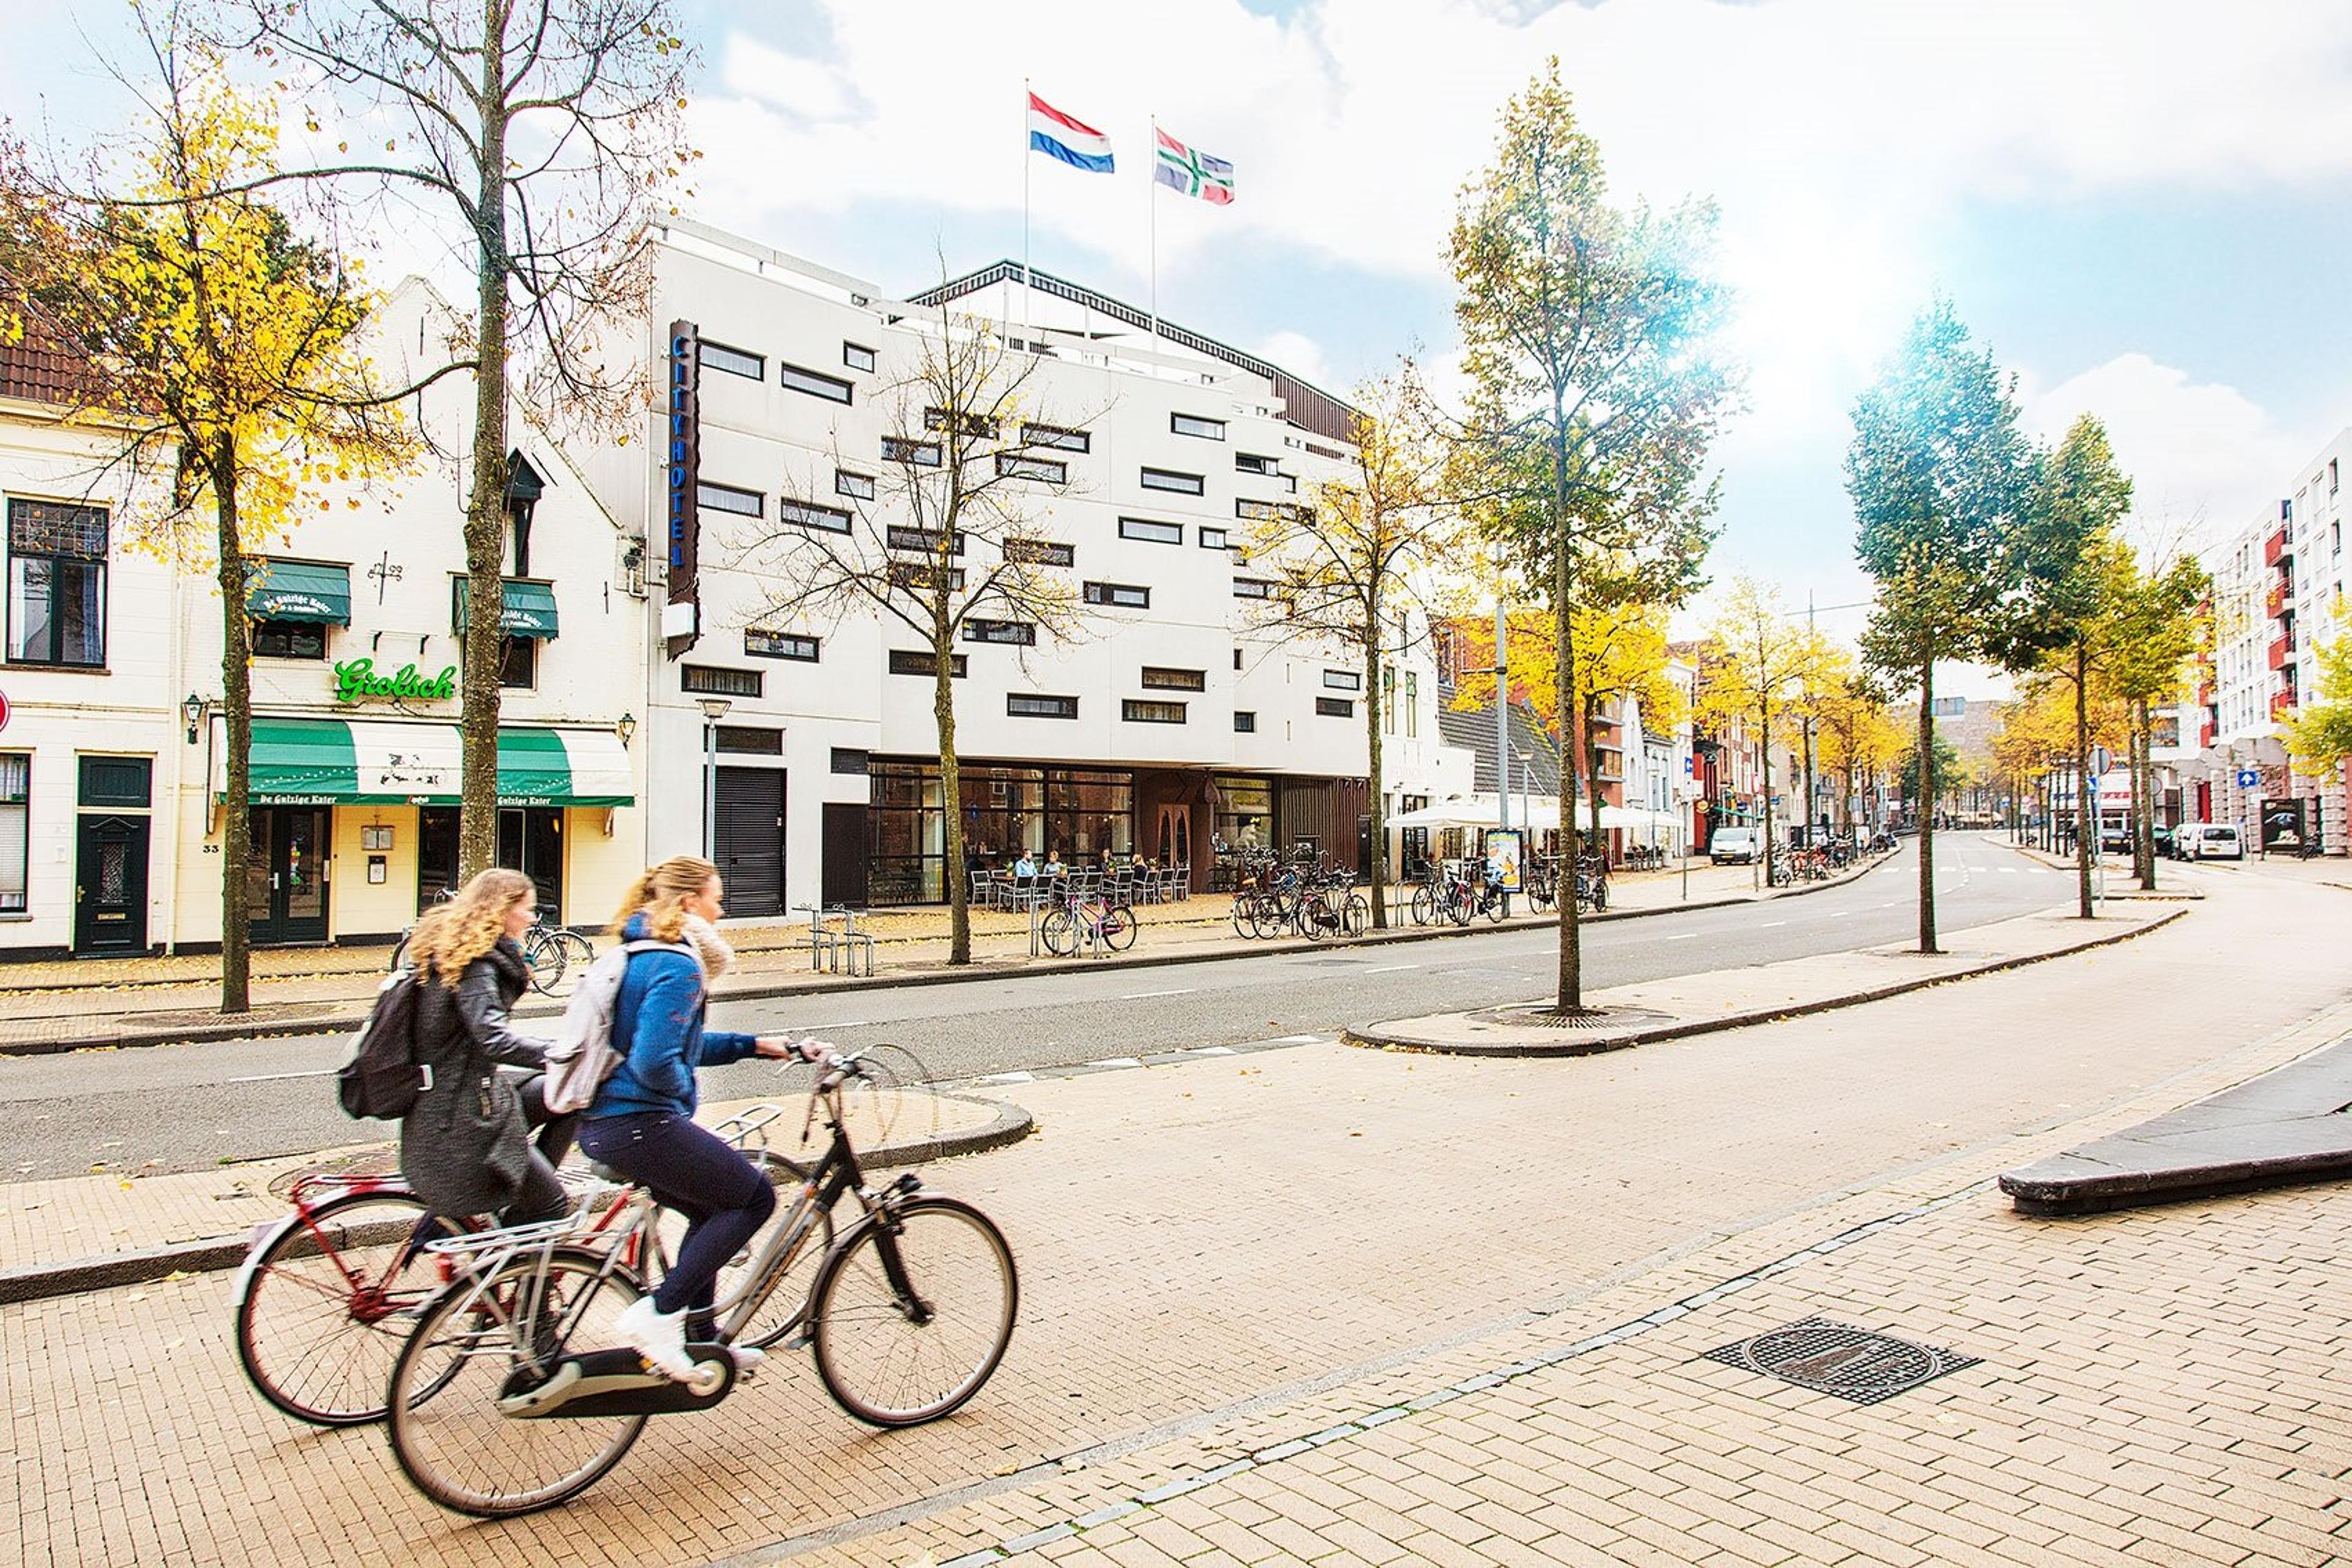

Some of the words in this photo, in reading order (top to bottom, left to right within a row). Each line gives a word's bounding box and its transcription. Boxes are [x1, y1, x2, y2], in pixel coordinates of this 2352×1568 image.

[334, 657, 458, 702] Grolsch
[260, 794, 273, 804] De
[203, 845, 219, 853] 33
